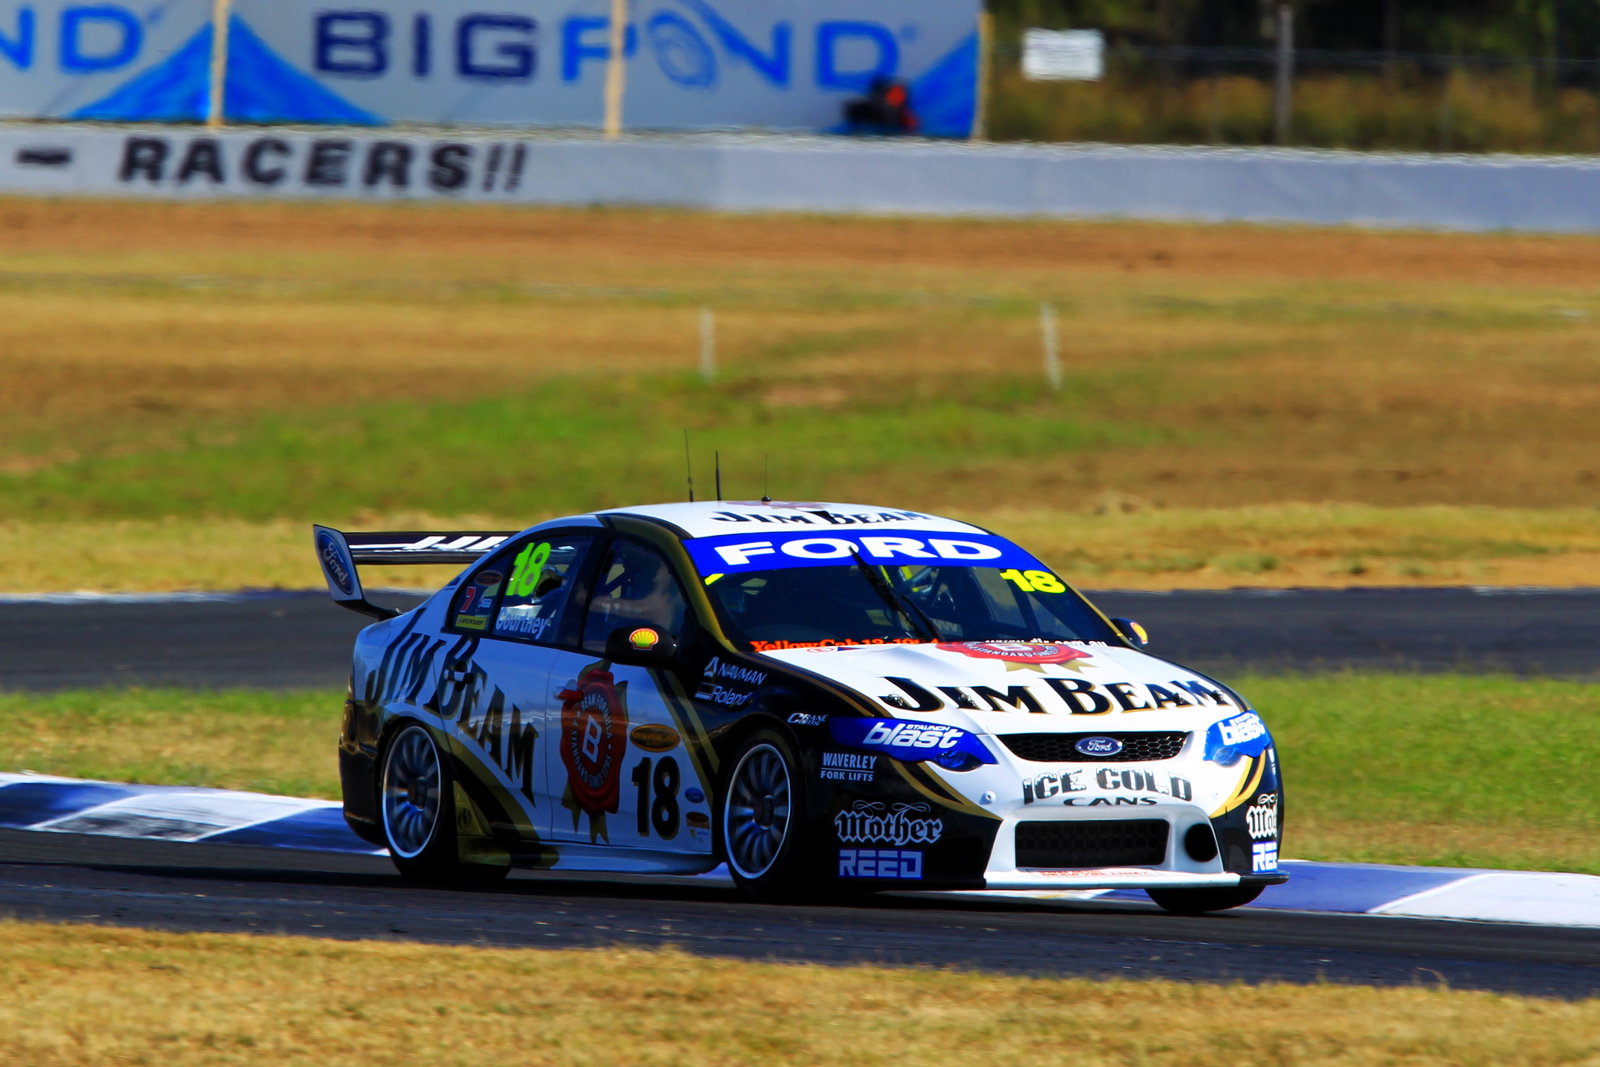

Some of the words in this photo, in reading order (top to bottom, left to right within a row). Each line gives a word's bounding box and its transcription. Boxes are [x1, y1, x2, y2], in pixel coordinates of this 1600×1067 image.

[118, 136, 527, 191] RACERS!!
[709, 510, 815, 525] JIM
[713, 536, 1003, 568] FORD
[505, 541, 552, 597] 18
[1000, 568, 1067, 595] 18
[495, 606, 549, 640] Courtney
[717, 662, 768, 686] NAVMAN
[710, 684, 753, 707] Roland
[876, 676, 1058, 714] JIM
[1035, 677, 1241, 716] BEAM
[863, 721, 966, 749] blast
[905, 723, 951, 732] STAUNCH
[1217, 711, 1266, 747] blast
[1087, 739, 1114, 753] Ford
[822, 752, 877, 770] WAVERLEY
[820, 770, 846, 781] FORK
[848, 771, 875, 782] LIFTS
[1023, 769, 1086, 805] ICE
[1096, 767, 1193, 801] COLD
[631, 755, 681, 841] 18
[1063, 795, 1158, 806] CANS
[834, 804, 943, 846] Mother
[839, 850, 923, 878] REED
